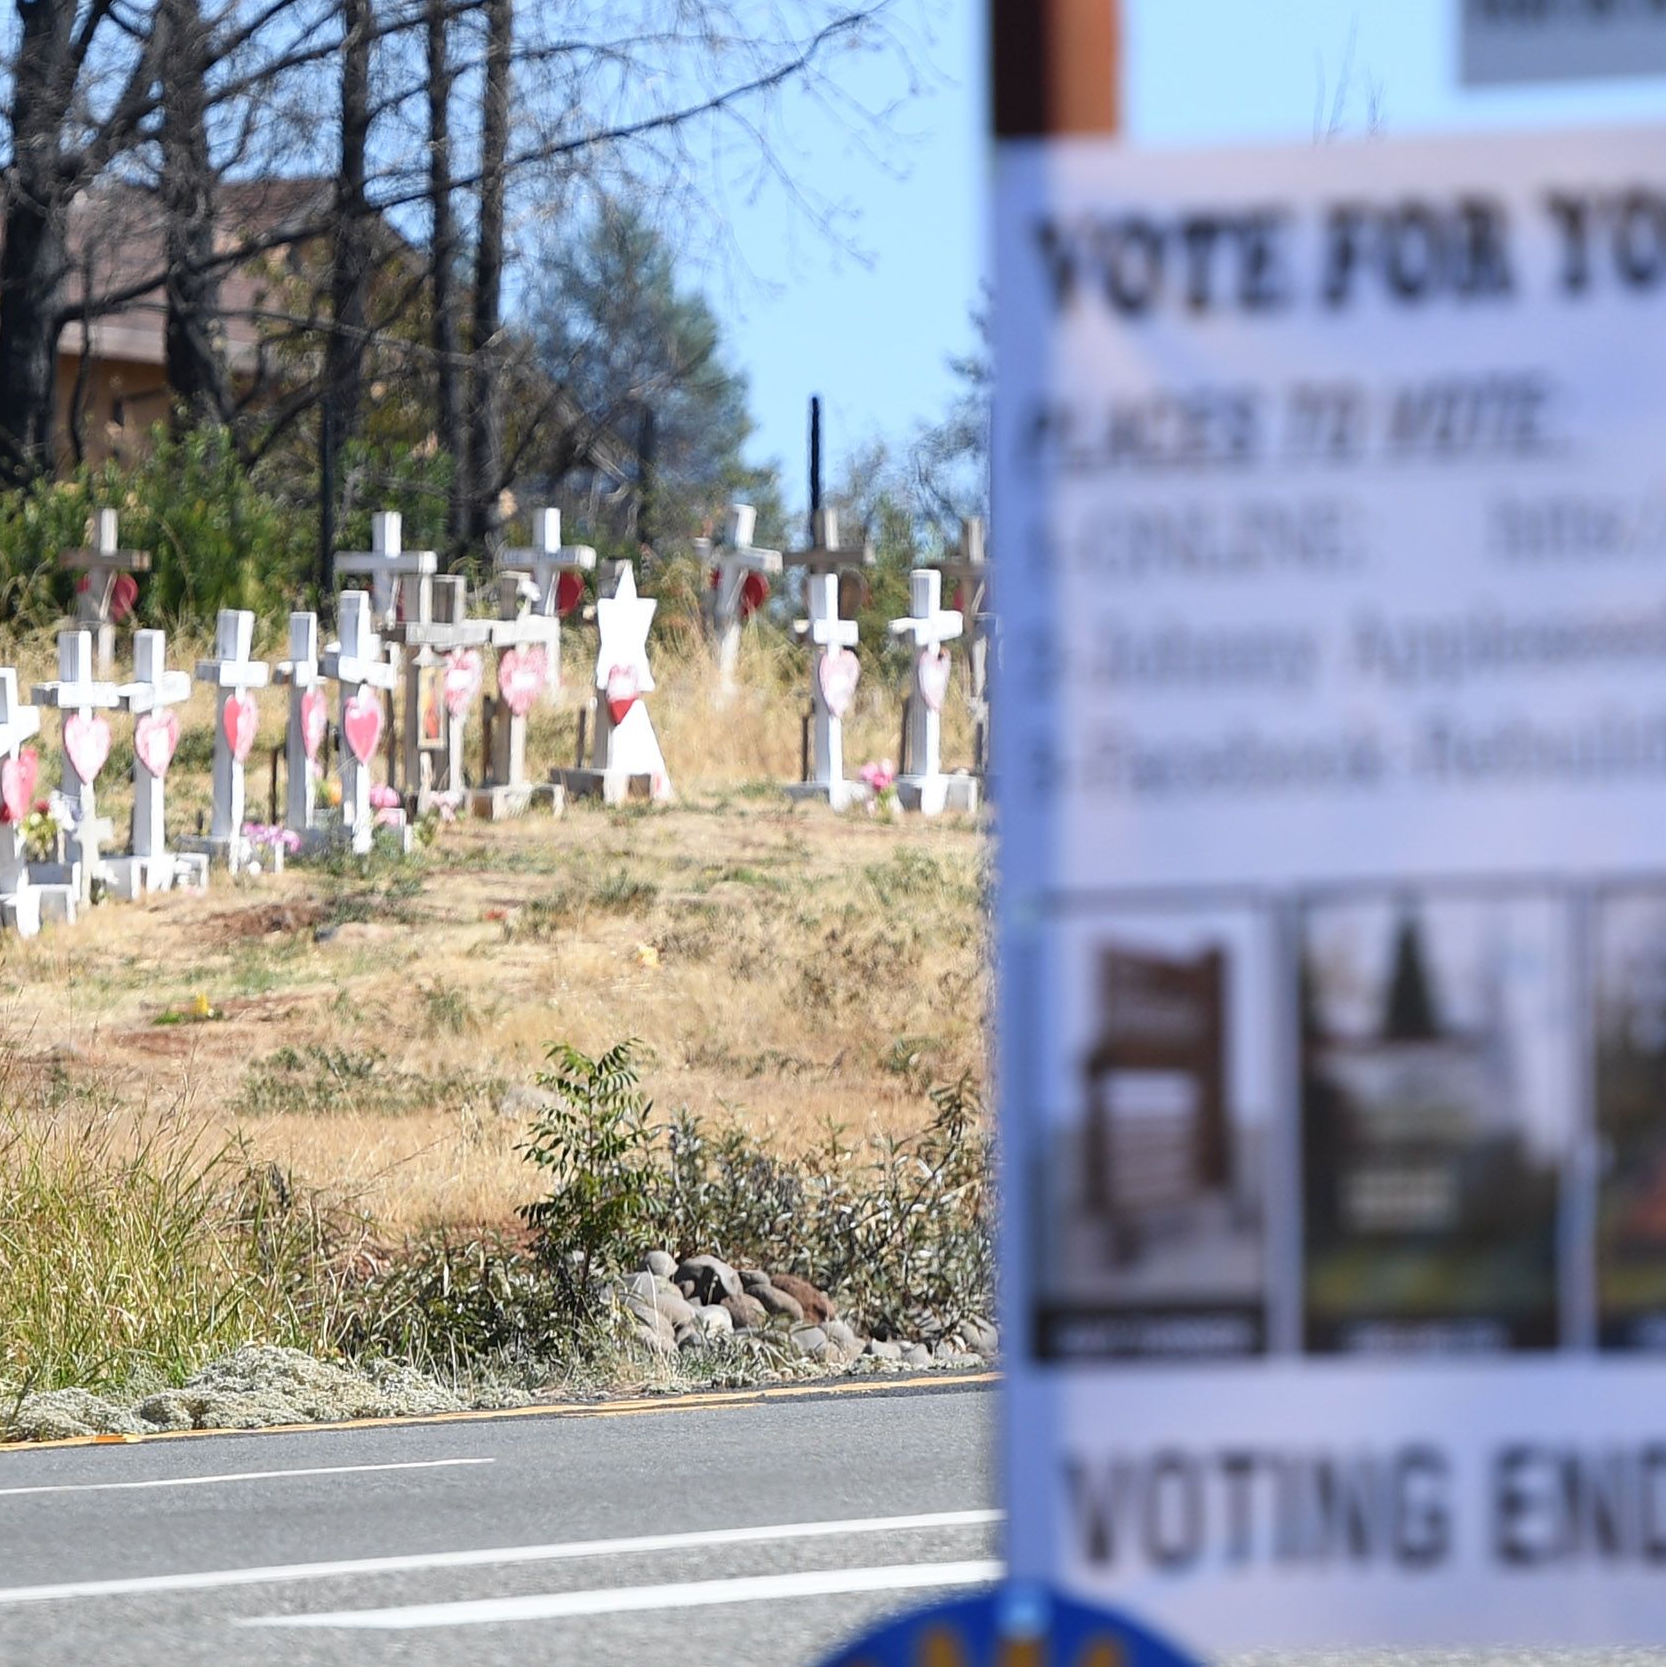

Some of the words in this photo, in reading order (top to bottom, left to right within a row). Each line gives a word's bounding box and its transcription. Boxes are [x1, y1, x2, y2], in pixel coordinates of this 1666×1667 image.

[1032, 200, 1293, 317] VOTE
[1321, 190, 1514, 309] FOR
[1014, 383, 1260, 479] PLACES
[1285, 378, 1364, 465] TO
[1064, 1443, 1453, 1578] VOTING
